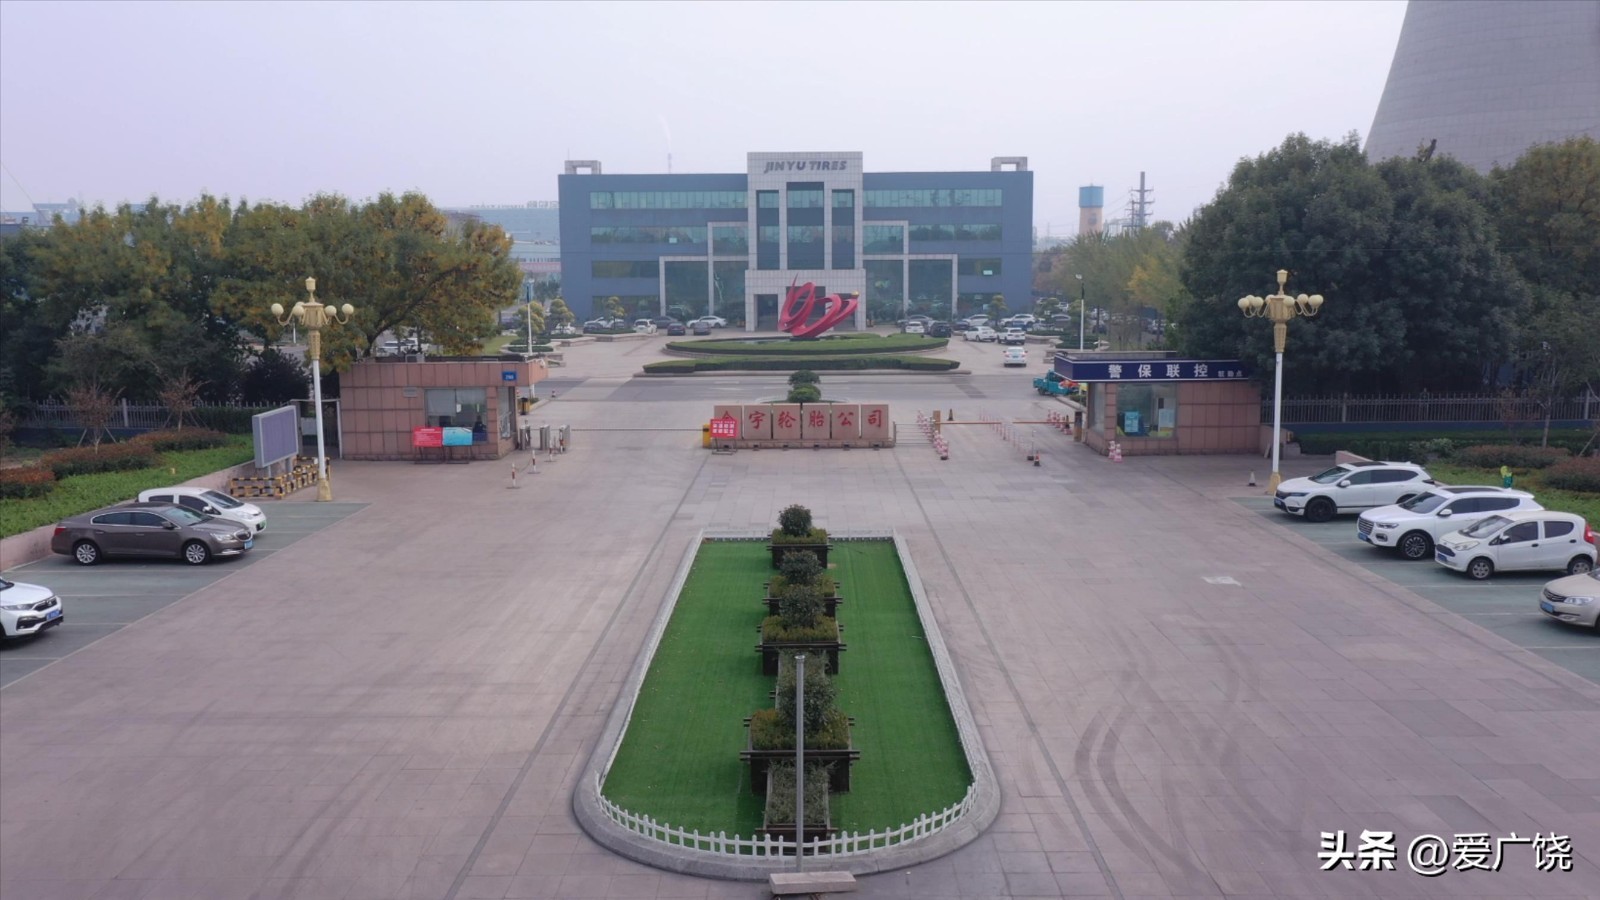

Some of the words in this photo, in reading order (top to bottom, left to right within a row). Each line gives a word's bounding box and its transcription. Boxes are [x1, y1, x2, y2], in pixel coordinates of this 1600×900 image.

[808, 161, 847, 171] TIRES
[1108, 364, 1208, 378] 警保联控
